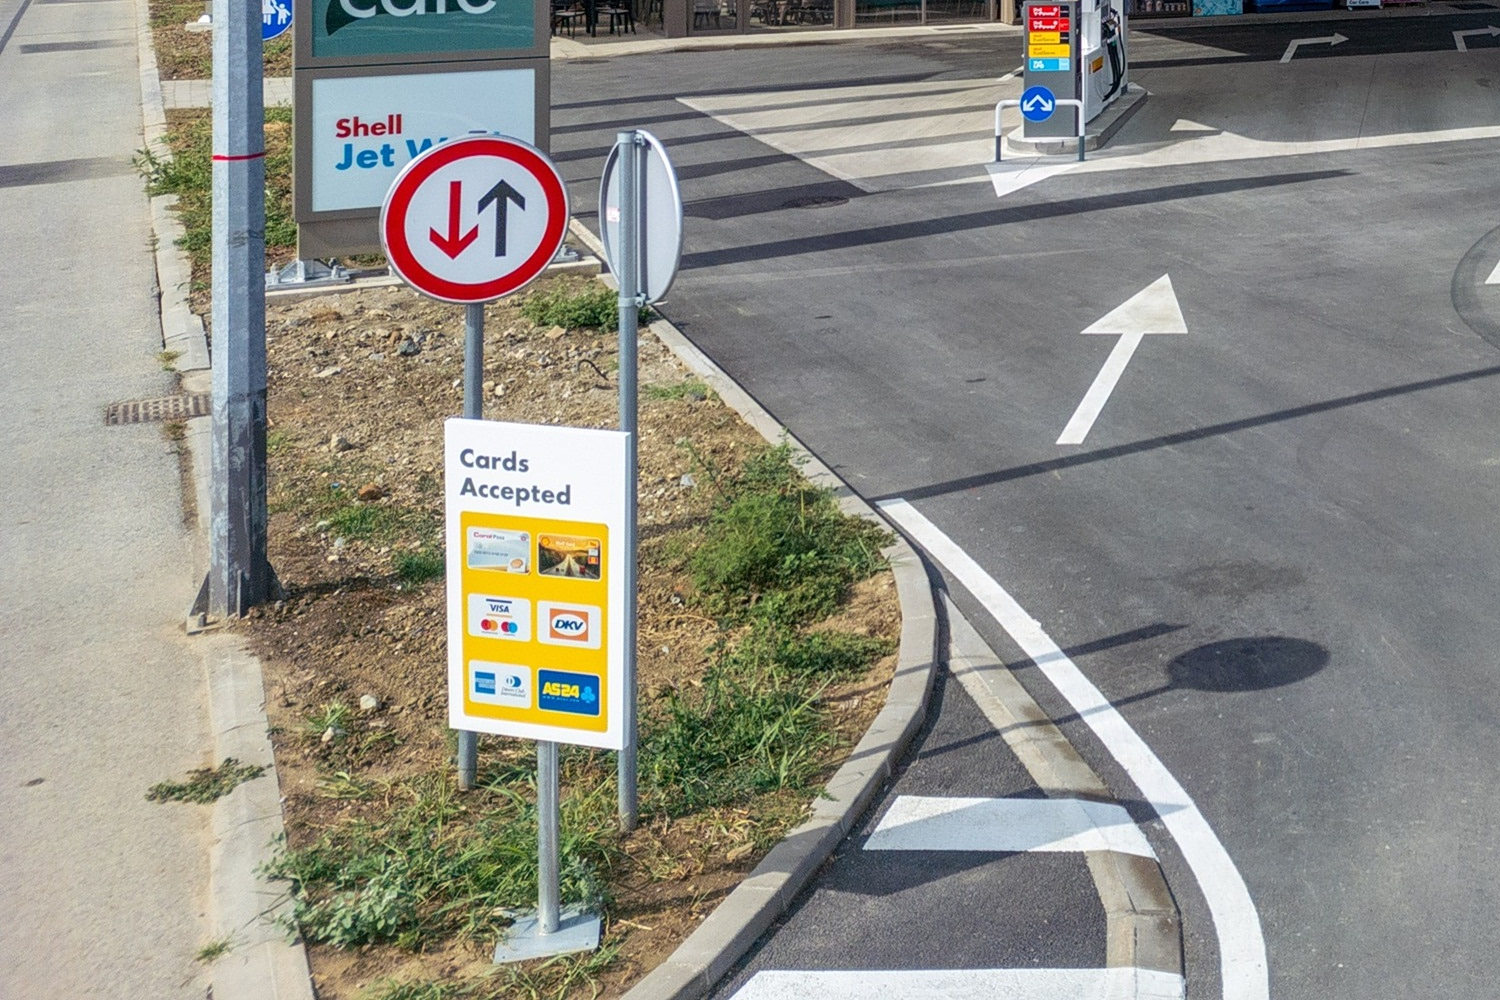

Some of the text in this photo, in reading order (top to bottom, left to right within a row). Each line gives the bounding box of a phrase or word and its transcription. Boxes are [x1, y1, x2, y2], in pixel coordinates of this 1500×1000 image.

[335, 114, 402, 138] Shell
[335, 143, 395, 171] Jet
[460, 448, 530, 473] Cards
[459, 477, 571, 507] Accepted
[490, 604, 510, 613] VISA
[554, 619, 583, 631] DKV
[542, 681, 580, 699] AS24
